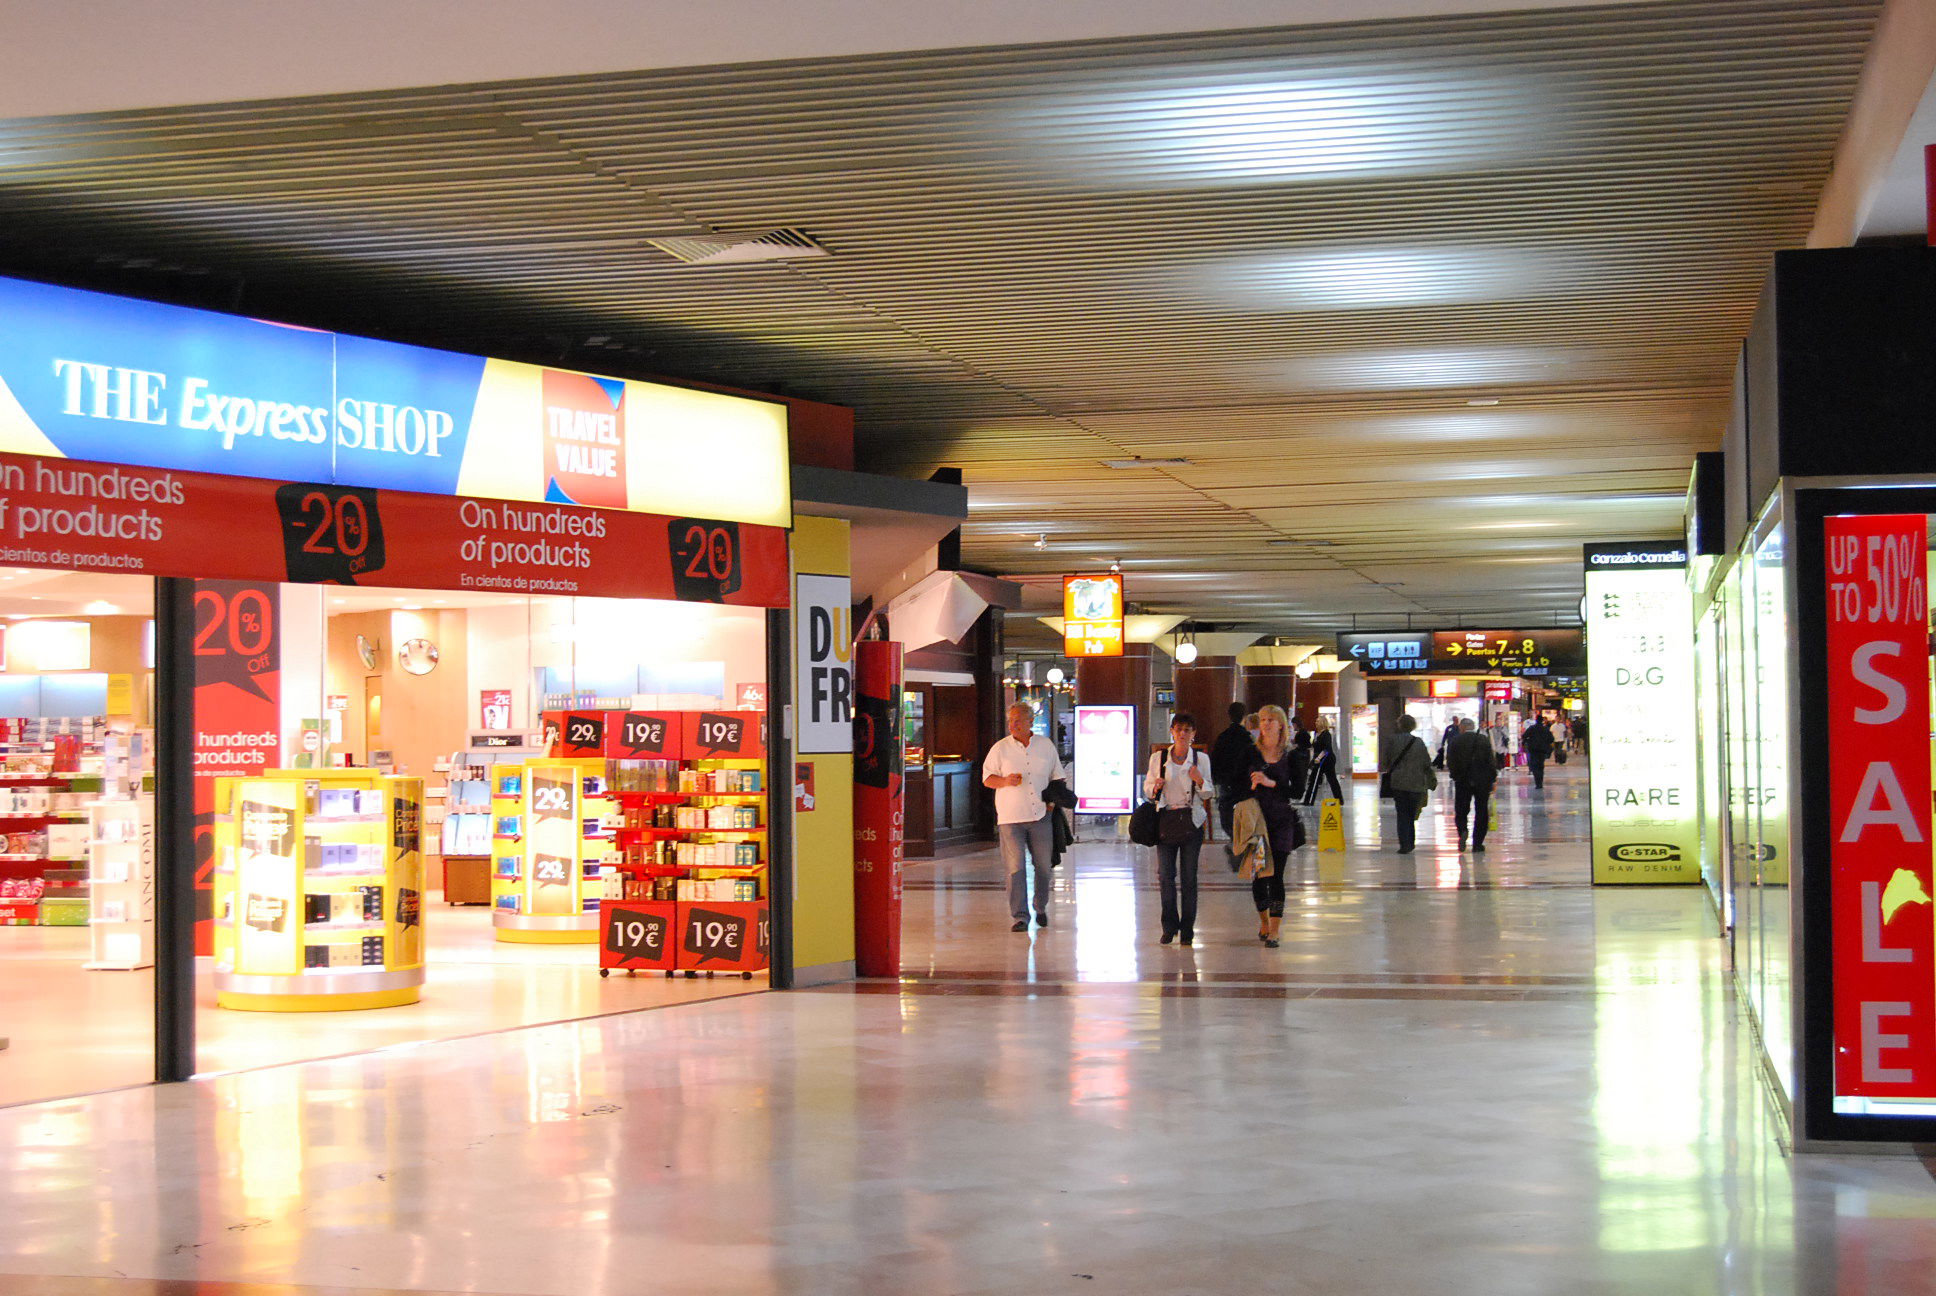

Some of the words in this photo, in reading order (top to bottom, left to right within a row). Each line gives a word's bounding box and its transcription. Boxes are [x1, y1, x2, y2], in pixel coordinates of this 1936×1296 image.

[55, 359, 167, 426] THE
[179, 376, 329, 450] Express
[337, 398, 454, 457] SHOP
[547, 406, 621, 446] TRAVEL
[555, 444, 617, 478] VALUE
[0, 460, 25, 491] n
[36, 460, 186, 505] hundreds
[18, 504, 163, 541] products
[460, 500, 497, 529] On
[503, 503, 607, 538] hundreds
[51, 549, 70, 564] de
[73, 551, 144, 569] productos
[460, 534, 487, 562] of
[490, 538, 592, 569] products
[1590, 552, 1639, 564] Gonzalo
[1830, 534, 1860, 575] UP
[460, 573, 474, 586] En
[475, 574, 512, 588] cientos
[513, 576, 528, 588] de
[529, 577, 579, 592] productos
[1866, 529, 1923, 625] 50%
[1830, 582, 1861, 623] TO
[810, 605, 851, 663] DU
[811, 666, 851, 723] FR
[1616, 666, 1664, 686] D&G
[199, 731, 278, 747] hundreds
[488, 737, 509, 747] Dior
[1620, 848, 1668, 856] G-STAR
[1840, 640, 1924, 1083] SALE
